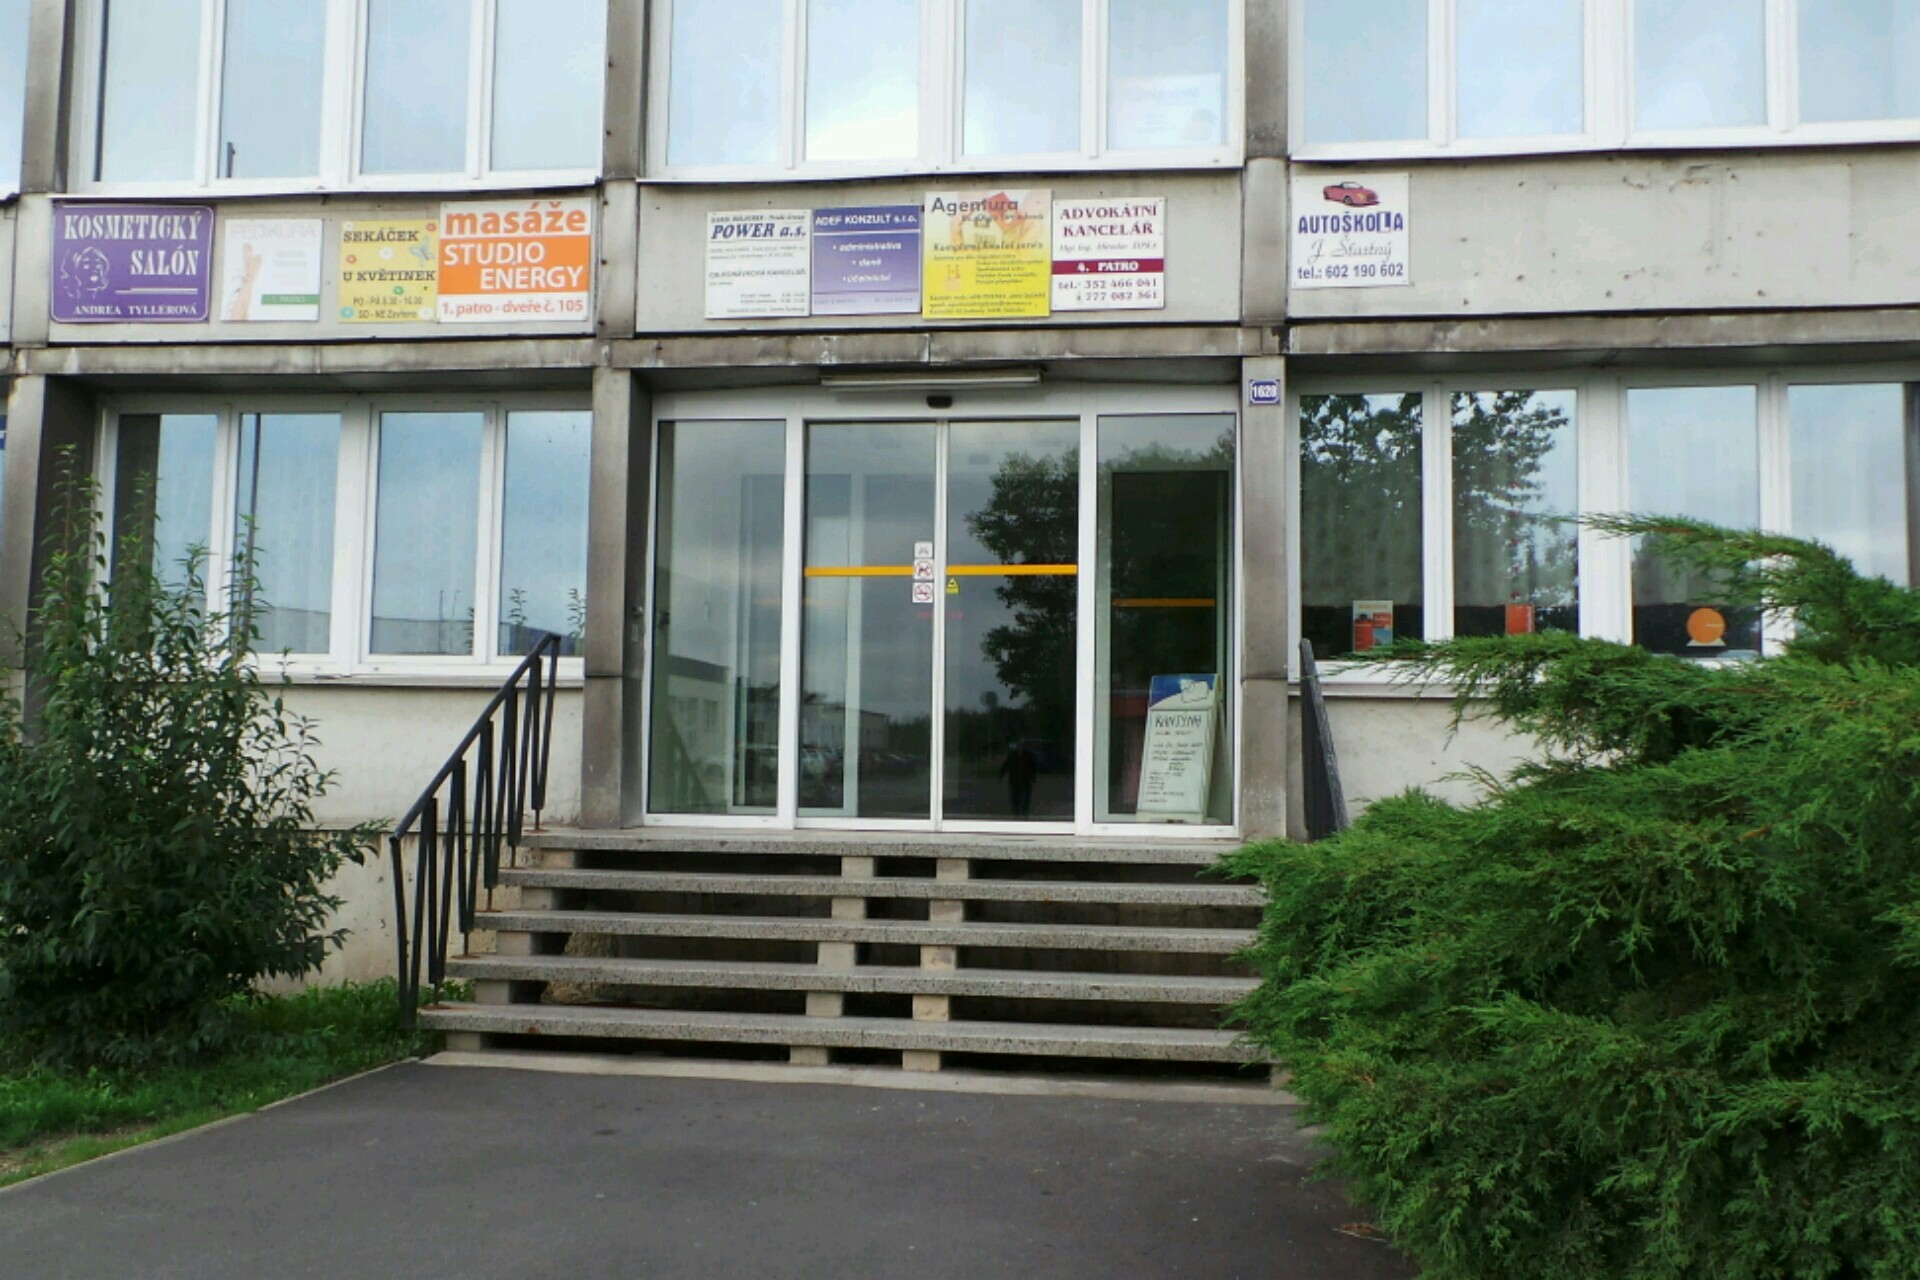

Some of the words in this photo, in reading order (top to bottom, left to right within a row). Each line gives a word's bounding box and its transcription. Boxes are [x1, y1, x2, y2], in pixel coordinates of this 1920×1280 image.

[931, 197, 1018, 216] Agentura
[1060, 203, 1157, 220] ADVOKÁTNÍ
[64, 211, 202, 240] KOSMETICKÝ
[445, 201, 587, 236] masáže
[845, 213, 892, 224] KONZULT
[1299, 211, 1404, 234] AUTOŠKOLA
[343, 229, 420, 242] SEKÁČEK
[711, 223, 775, 239] POWER
[779, 225, 807, 238] a.s.
[1063, 221, 1153, 237] KANCELÁŘ
[130, 246, 199, 275] SALÓN
[443, 242, 545, 265] STUDIO
[1077, 262, 1090, 272] 4.
[1098, 261, 1139, 271] PATRO
[1325, 264, 1349, 279] 602
[1354, 264, 1376, 278] 190
[1380, 262, 1404, 277] 602
[343, 271, 353, 282] U
[357, 269, 436, 282] KVĚTINEK
[480, 266, 584, 290] ENERGY
[73, 304, 122, 316] ANDREA
[128, 302, 197, 315] TYLLEROVÁ
[442, 302, 454, 315] 1.
[457, 303, 492, 318] patro
[503, 300, 541, 313] dveře
[543, 299, 554, 312] č.
[558, 300, 584, 312] 105
